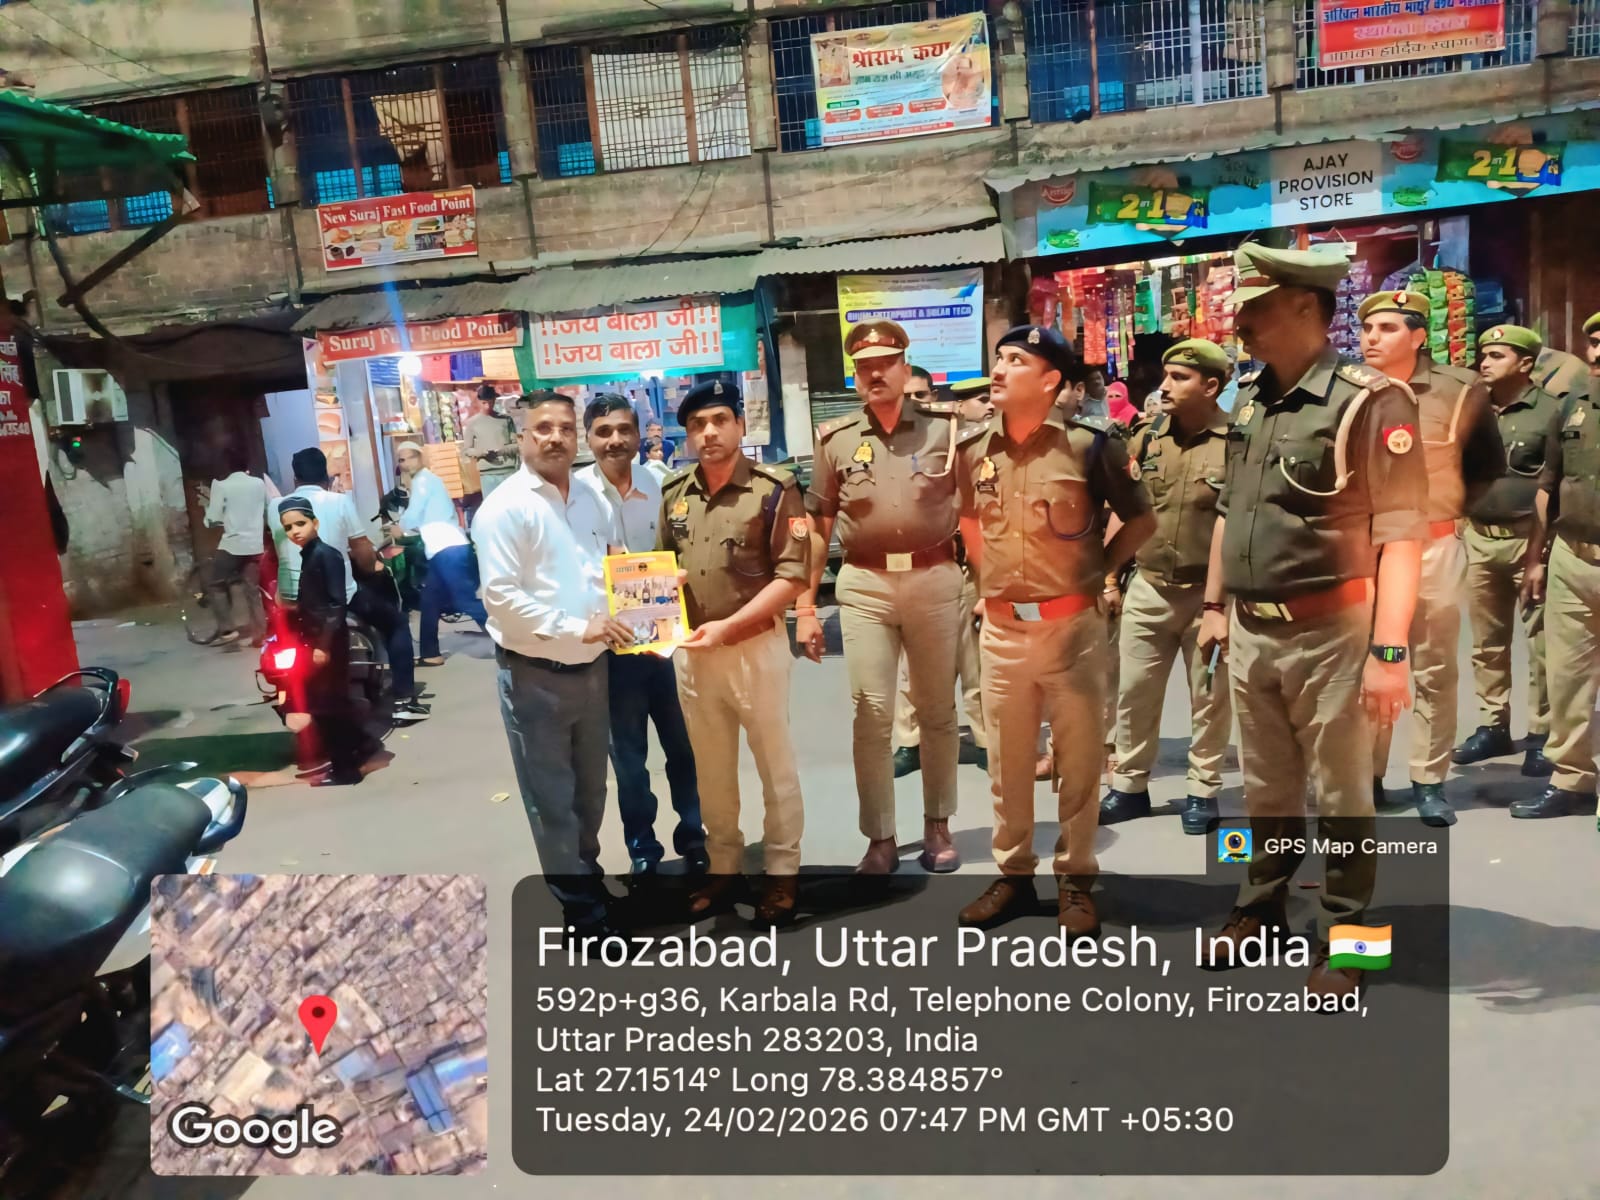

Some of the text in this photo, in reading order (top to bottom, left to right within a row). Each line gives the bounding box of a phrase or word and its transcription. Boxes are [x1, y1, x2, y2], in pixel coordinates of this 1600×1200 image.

[1363, 2, 1400, 18] भारतीय
[1303, 153, 1349, 172] AJAY
[1467, 150, 1492, 177] 2
[1498, 146, 1517, 175] 1
[1279, 169, 1374, 195] PROVISION
[324, 212, 347, 225] New
[350, 207, 380, 225] Suraj
[383, 204, 407, 218] Fast
[410, 200, 438, 215] Food
[441, 197, 471, 213] Point
[1116, 193, 1140, 218] 2
[1146, 189, 1164, 218] 1
[1300, 192, 1354, 211] STORE
[606, 310, 659, 332] बाला
[329, 332, 376, 354] Suraj
[420, 323, 461, 342] Food
[466, 319, 509, 338] Point
[543, 342, 603, 366] !!जय
[609, 338, 662, 361] बाला
[667, 329, 721, 355] जी!!
